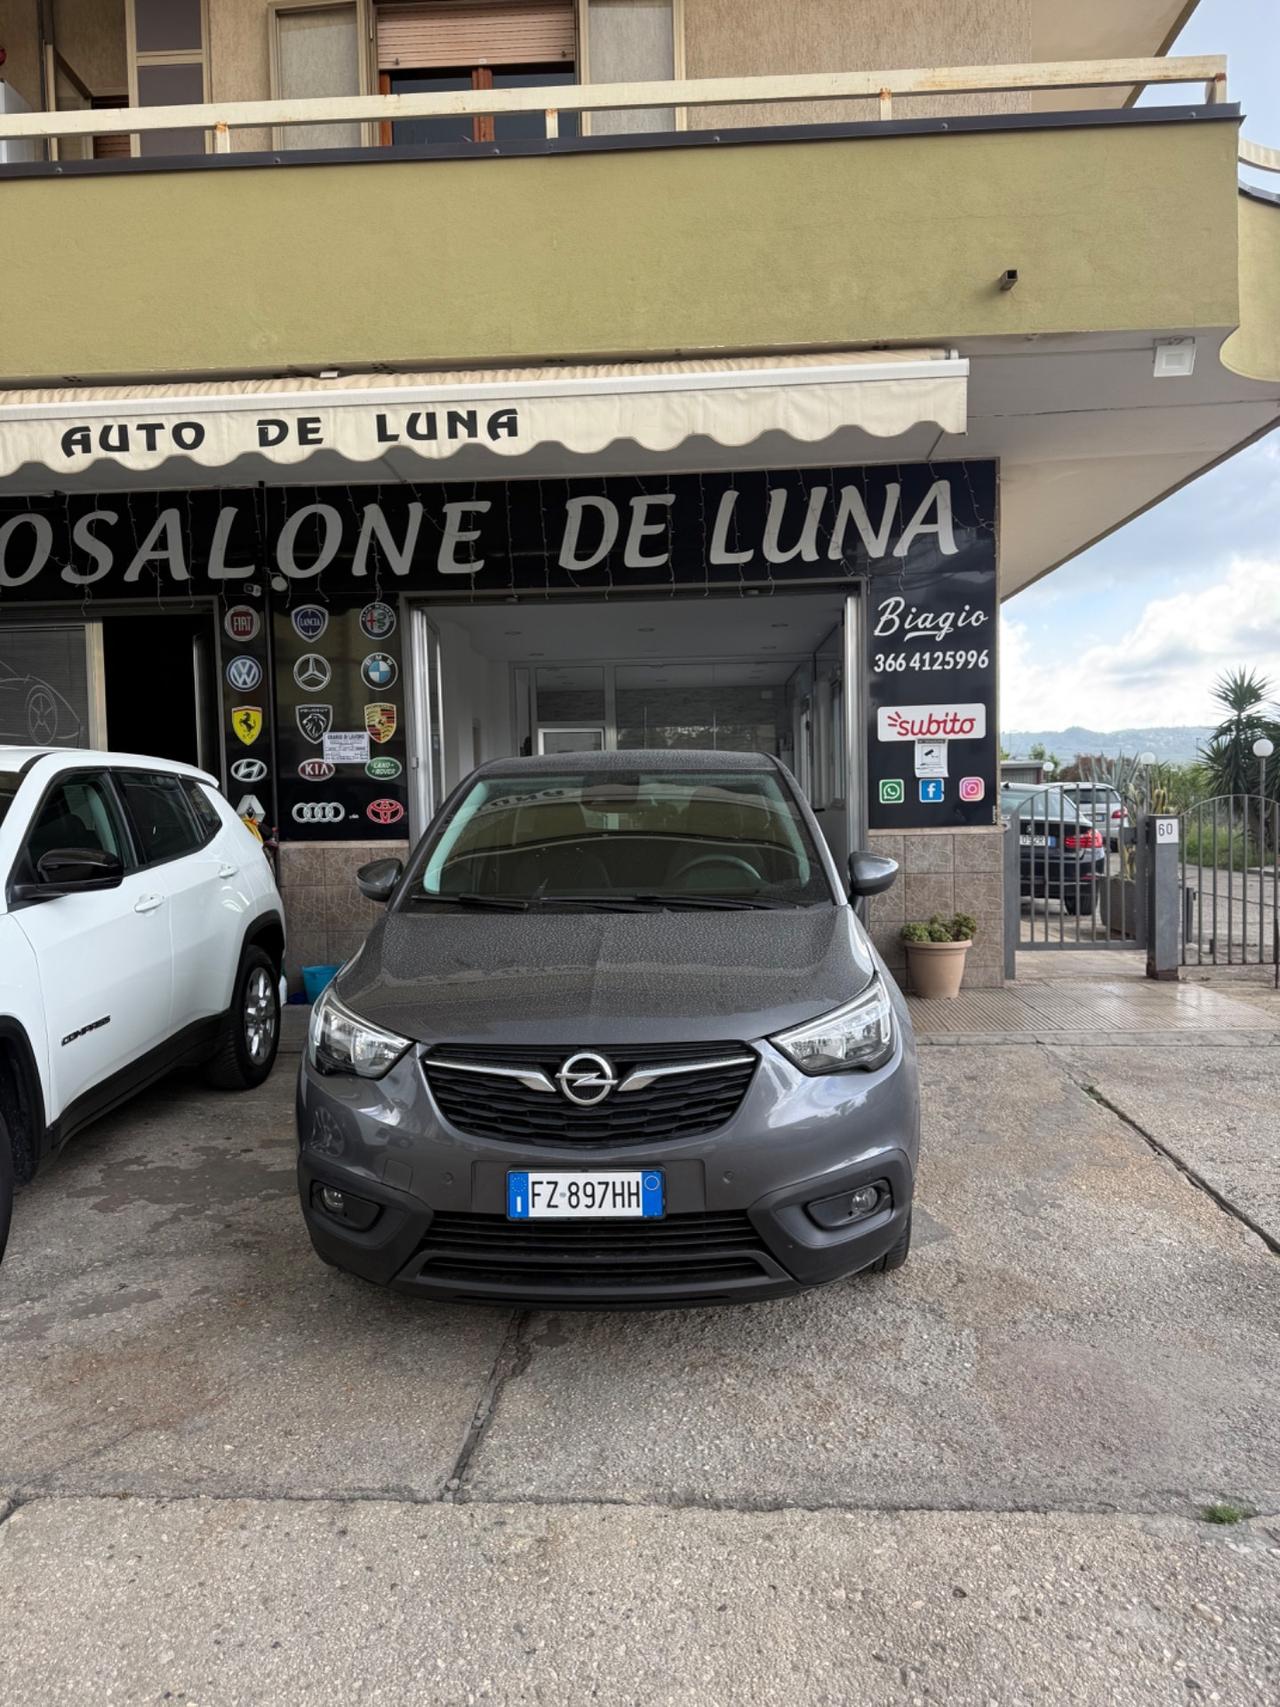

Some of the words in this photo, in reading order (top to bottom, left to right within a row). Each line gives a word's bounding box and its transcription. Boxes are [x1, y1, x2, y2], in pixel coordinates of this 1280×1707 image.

[61, 421, 206, 458] AUTO
[256, 416, 324, 447] DE
[376, 408, 519, 442] LUNA
[558, 493, 676, 571] DE
[709, 479, 959, 564] LUNA
[233, 616, 252, 632] FIAT
[300, 617, 321, 627] LANCIA
[873, 596, 989, 641] Biagio
[873, 652, 907, 672] 366
[909, 649, 990, 671] 4125996
[897, 712, 977, 737] subito
[304, 763, 329, 775] KIA
[1158, 823, 1173, 837] 60
